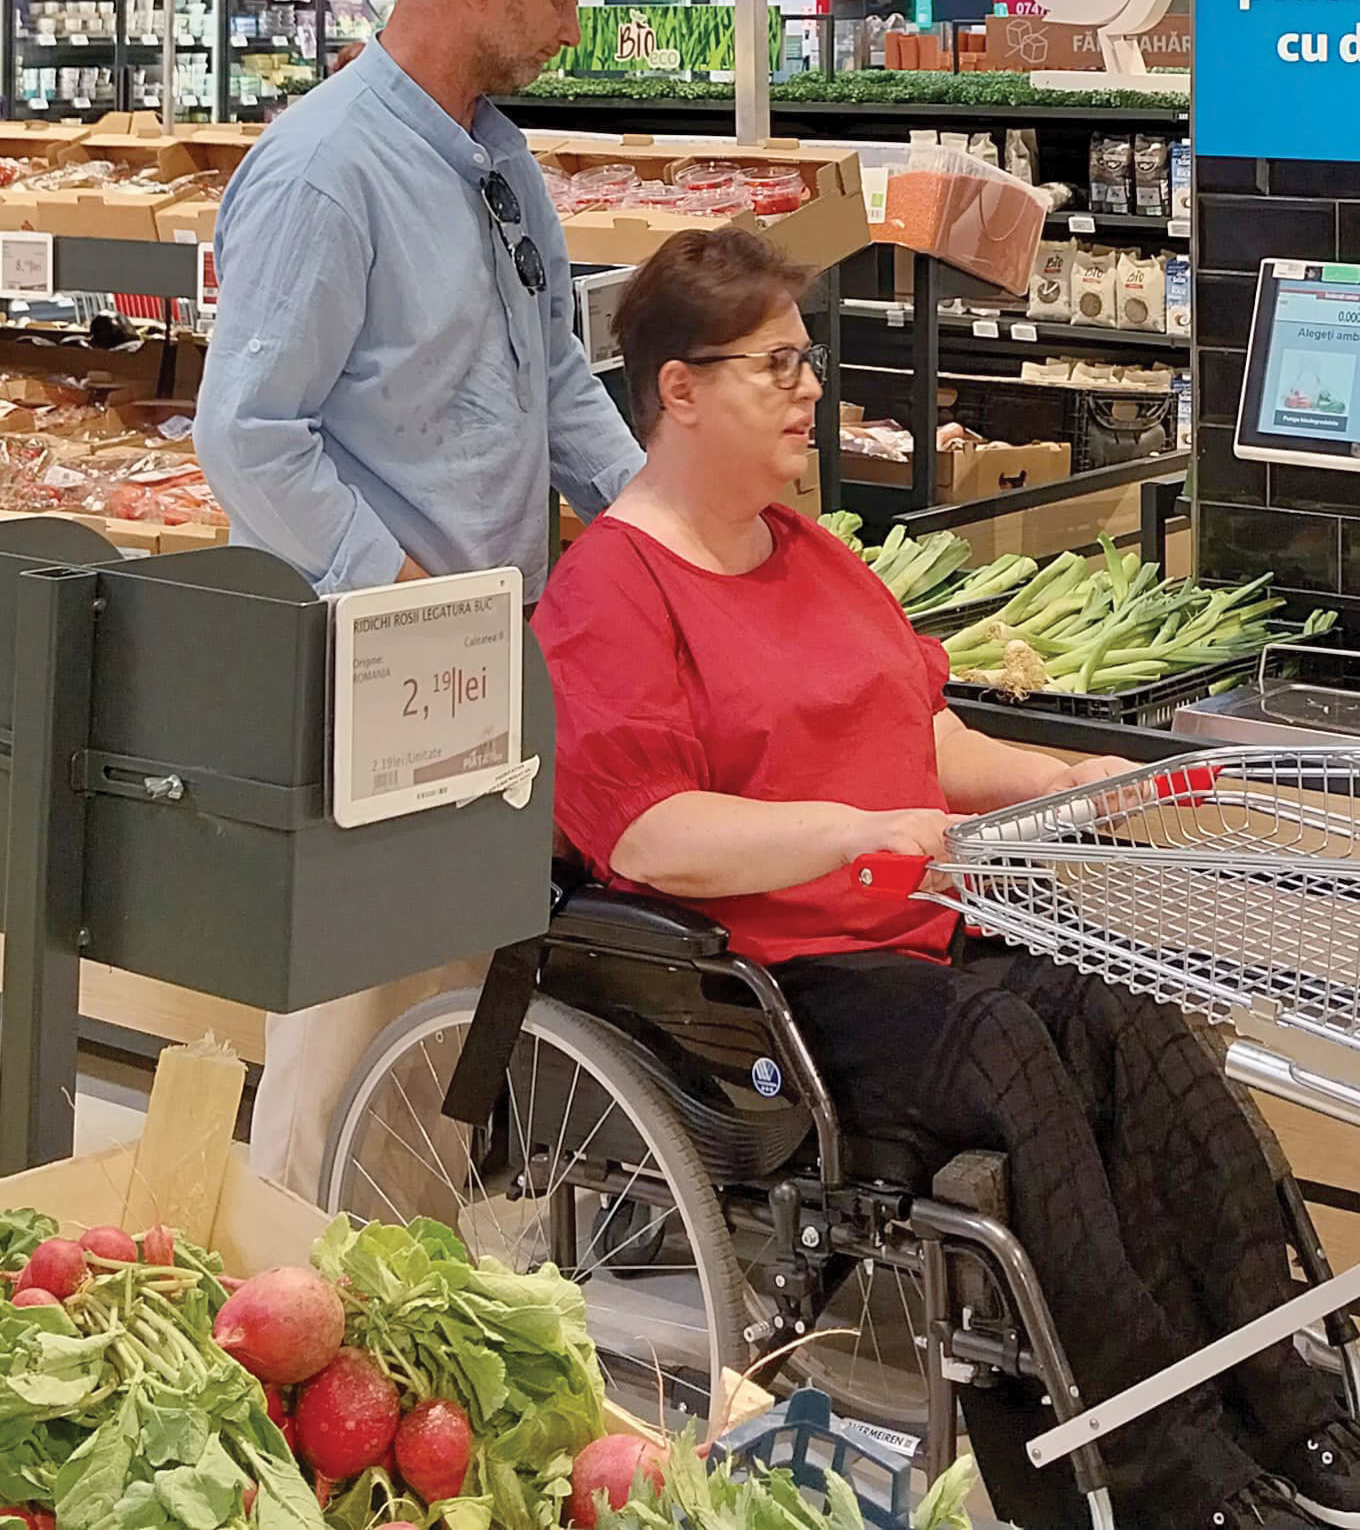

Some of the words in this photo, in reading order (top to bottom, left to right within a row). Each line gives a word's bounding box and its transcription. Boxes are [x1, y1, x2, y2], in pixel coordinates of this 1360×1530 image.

[650, 51, 678, 66] eco
[1276, 30, 1328, 63] cu
[353, 612, 392, 634] RIDICHI
[393, 610, 420, 628] ROSII
[422, 599, 472, 623] LEGATURA
[474, 597, 494, 613] BUC
